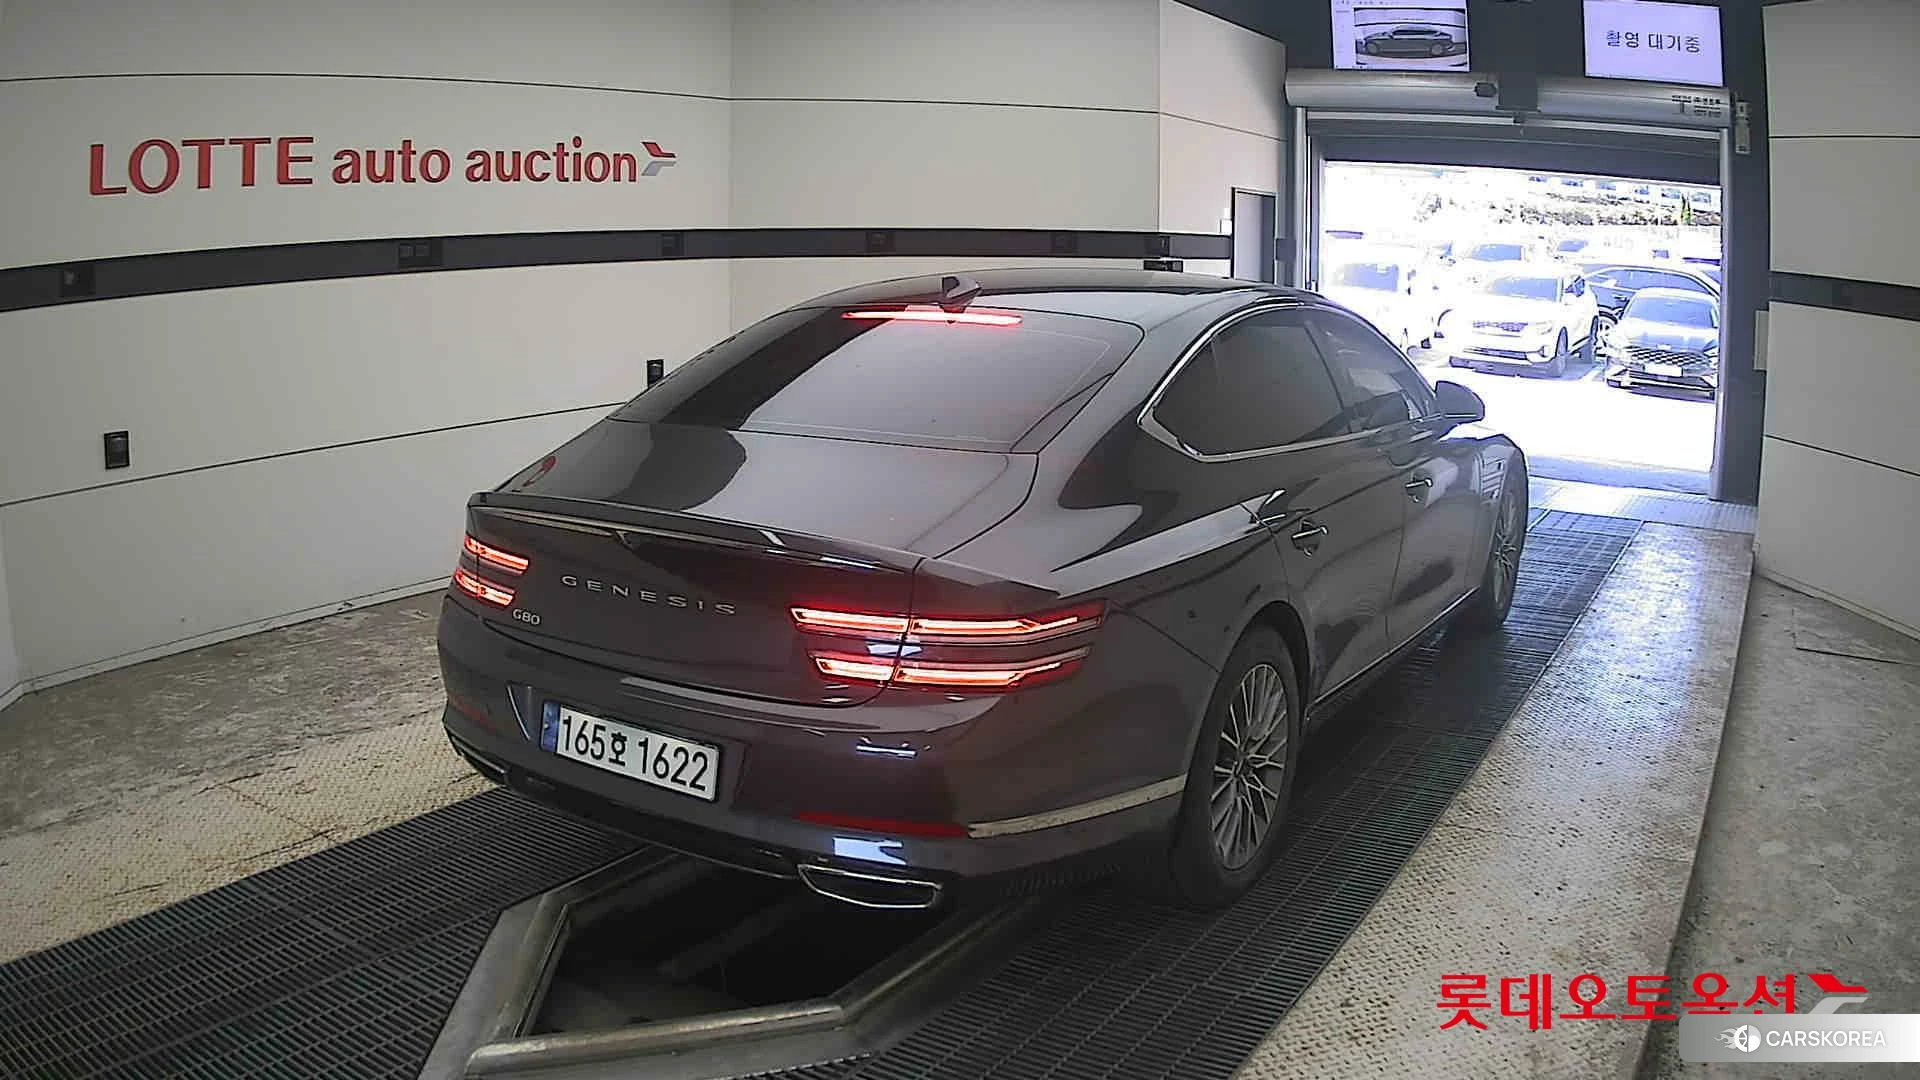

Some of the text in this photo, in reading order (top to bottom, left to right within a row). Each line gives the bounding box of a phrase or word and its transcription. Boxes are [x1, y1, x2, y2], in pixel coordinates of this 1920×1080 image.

[1606, 30, 1701, 53] 촬영 대기중
[89, 135, 638, 196] LOTTE auto auction
[561, 575, 735, 616] GENESIS
[512, 608, 541, 625] G80
[562, 715, 709, 792] 165호 1622
